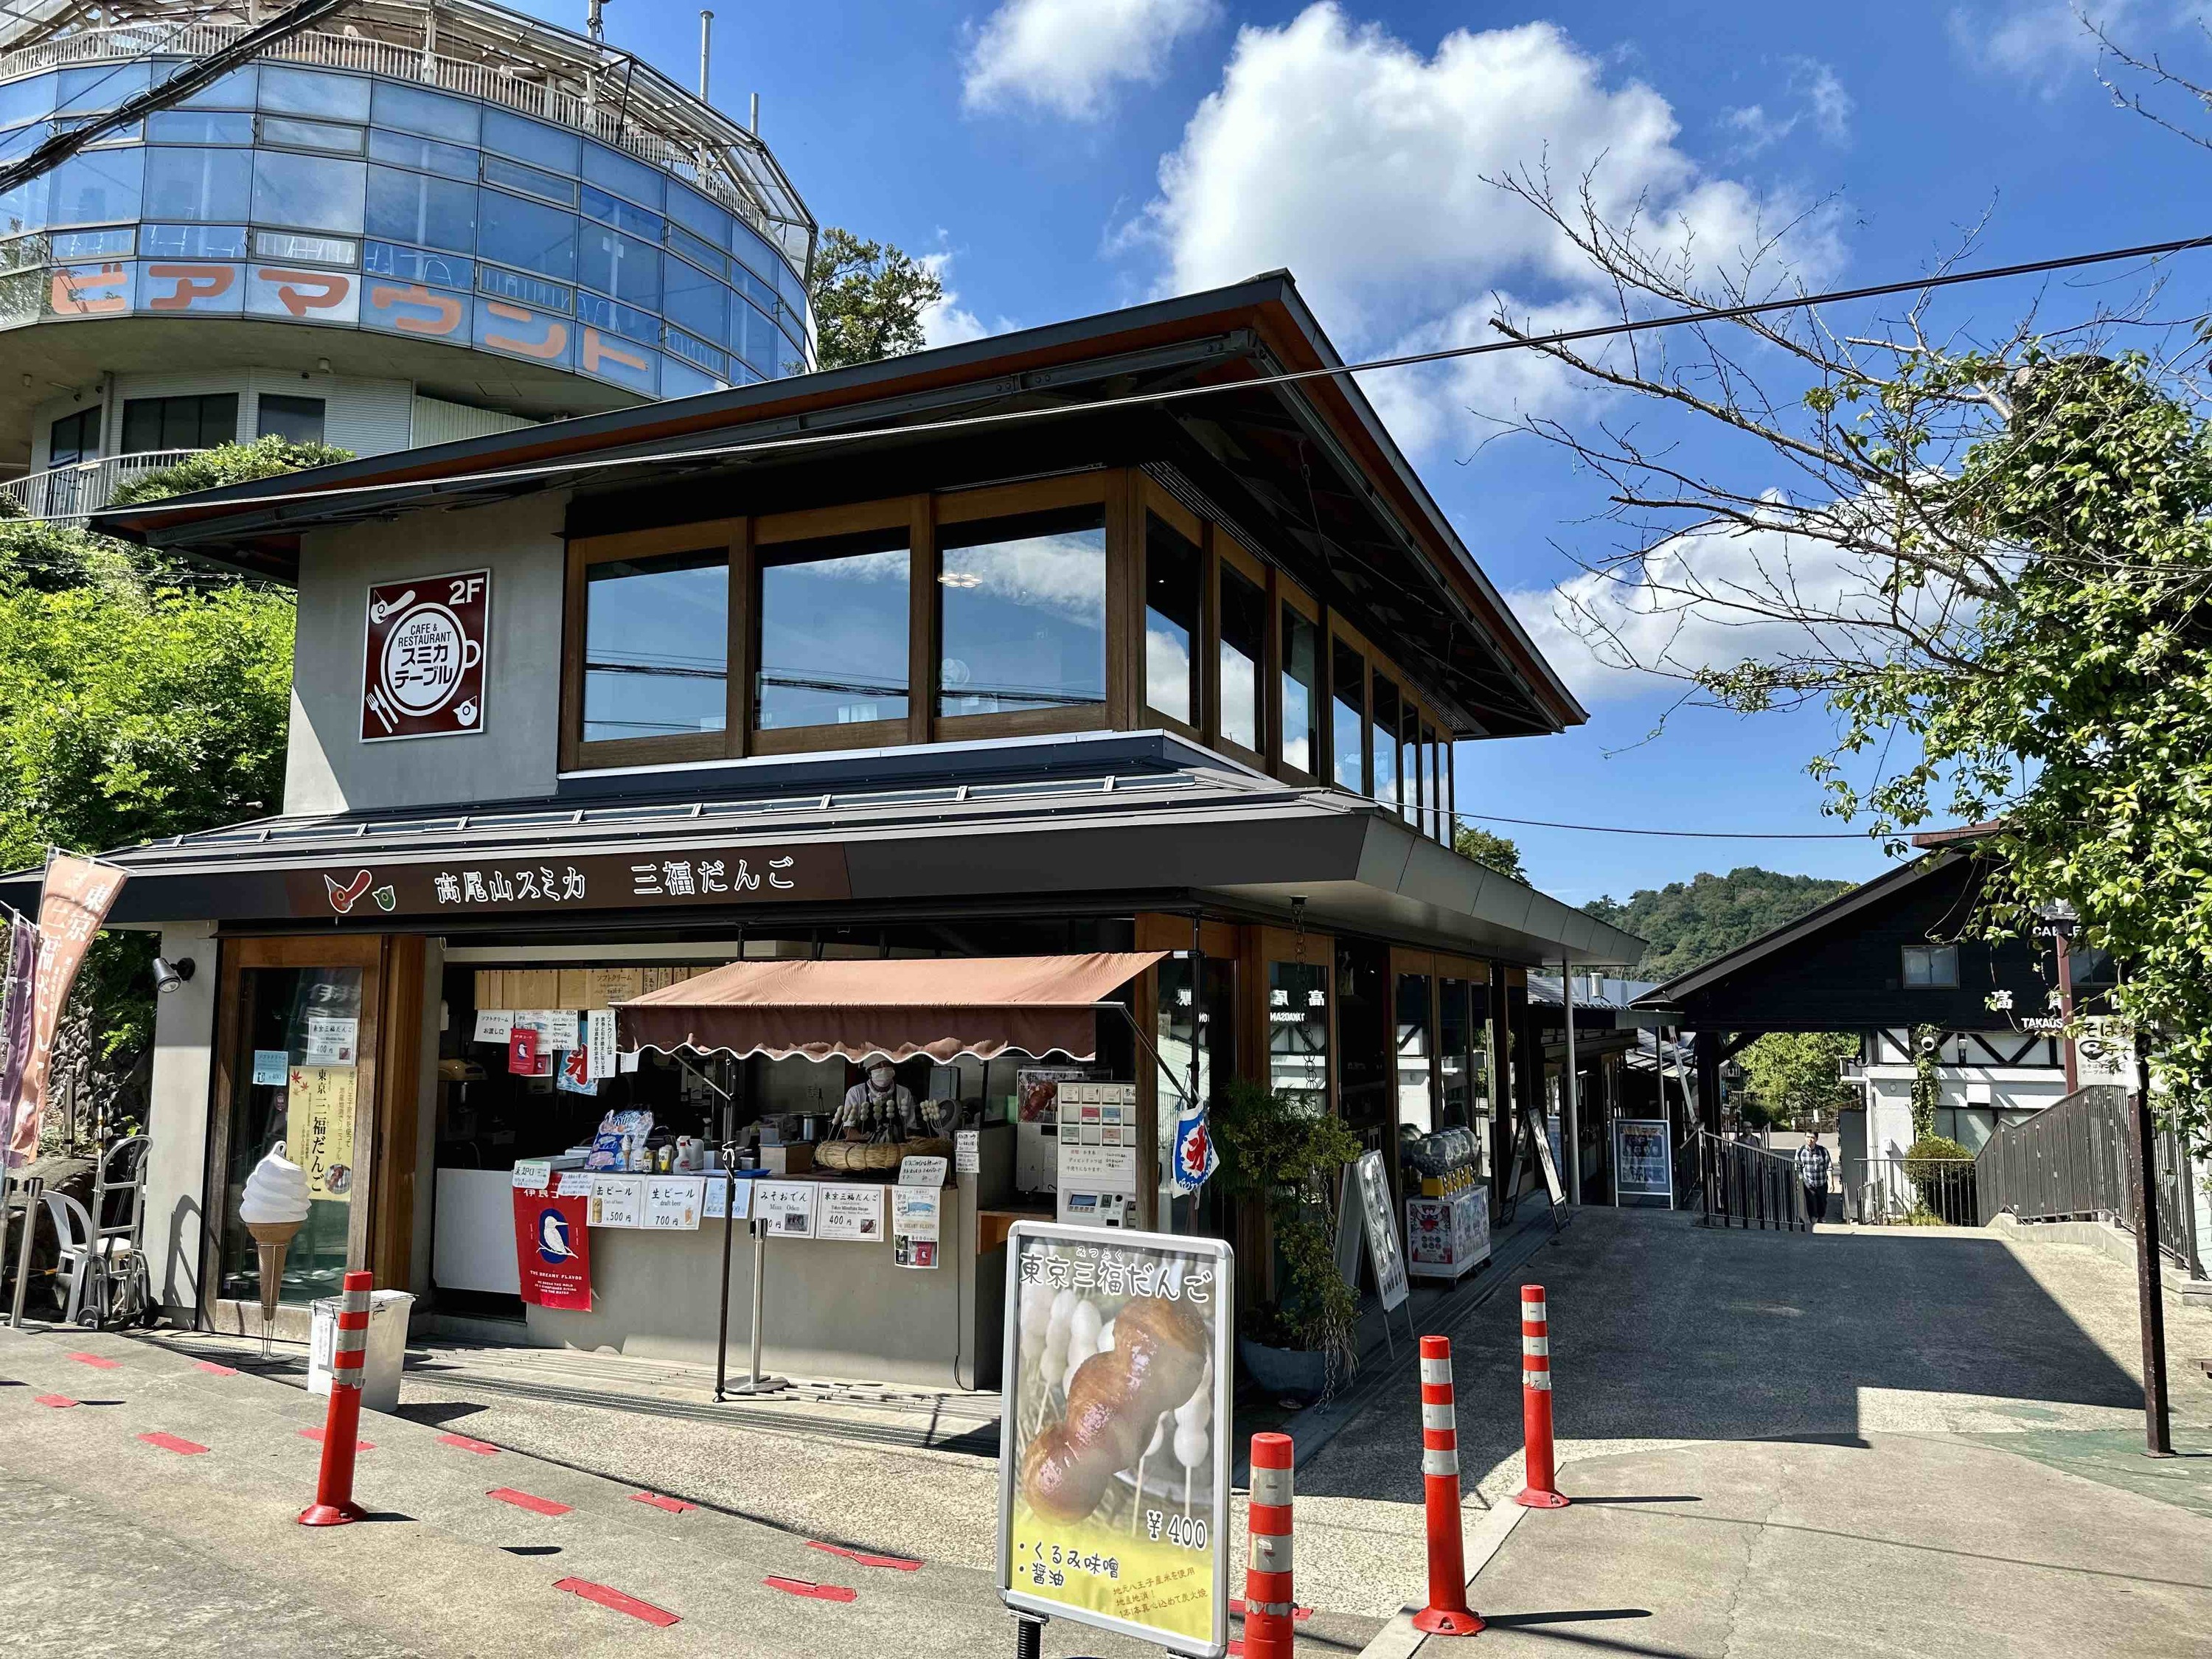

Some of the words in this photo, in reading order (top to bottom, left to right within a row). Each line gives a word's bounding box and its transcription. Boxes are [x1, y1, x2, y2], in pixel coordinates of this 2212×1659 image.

[51, 262, 649, 373] ビアマウント
[448, 577, 484, 605] 2F
[410, 623, 431, 635] CAFE
[398, 631, 452, 647] RESTAURANT
[401, 644, 448, 667] スミカ
[394, 665, 453, 689] テーブル
[434, 866, 586, 905] 高尾山スミカ
[630, 855, 795, 897] 三福だんご
[2032, 925, 2081, 936] CABE
[311, 1068, 327, 1192] 東京三福だんご
[597, 1185, 633, 1196] 缶ビール
[652, 1188, 695, 1200] 生ビール
[760, 1191, 808, 1202] みそおでん
[824, 1192, 878, 1202] 東京三福だんご
[1076, 1246, 1124, 1260] みつふく
[1020, 1253, 1214, 1304] 東京三福だんご
